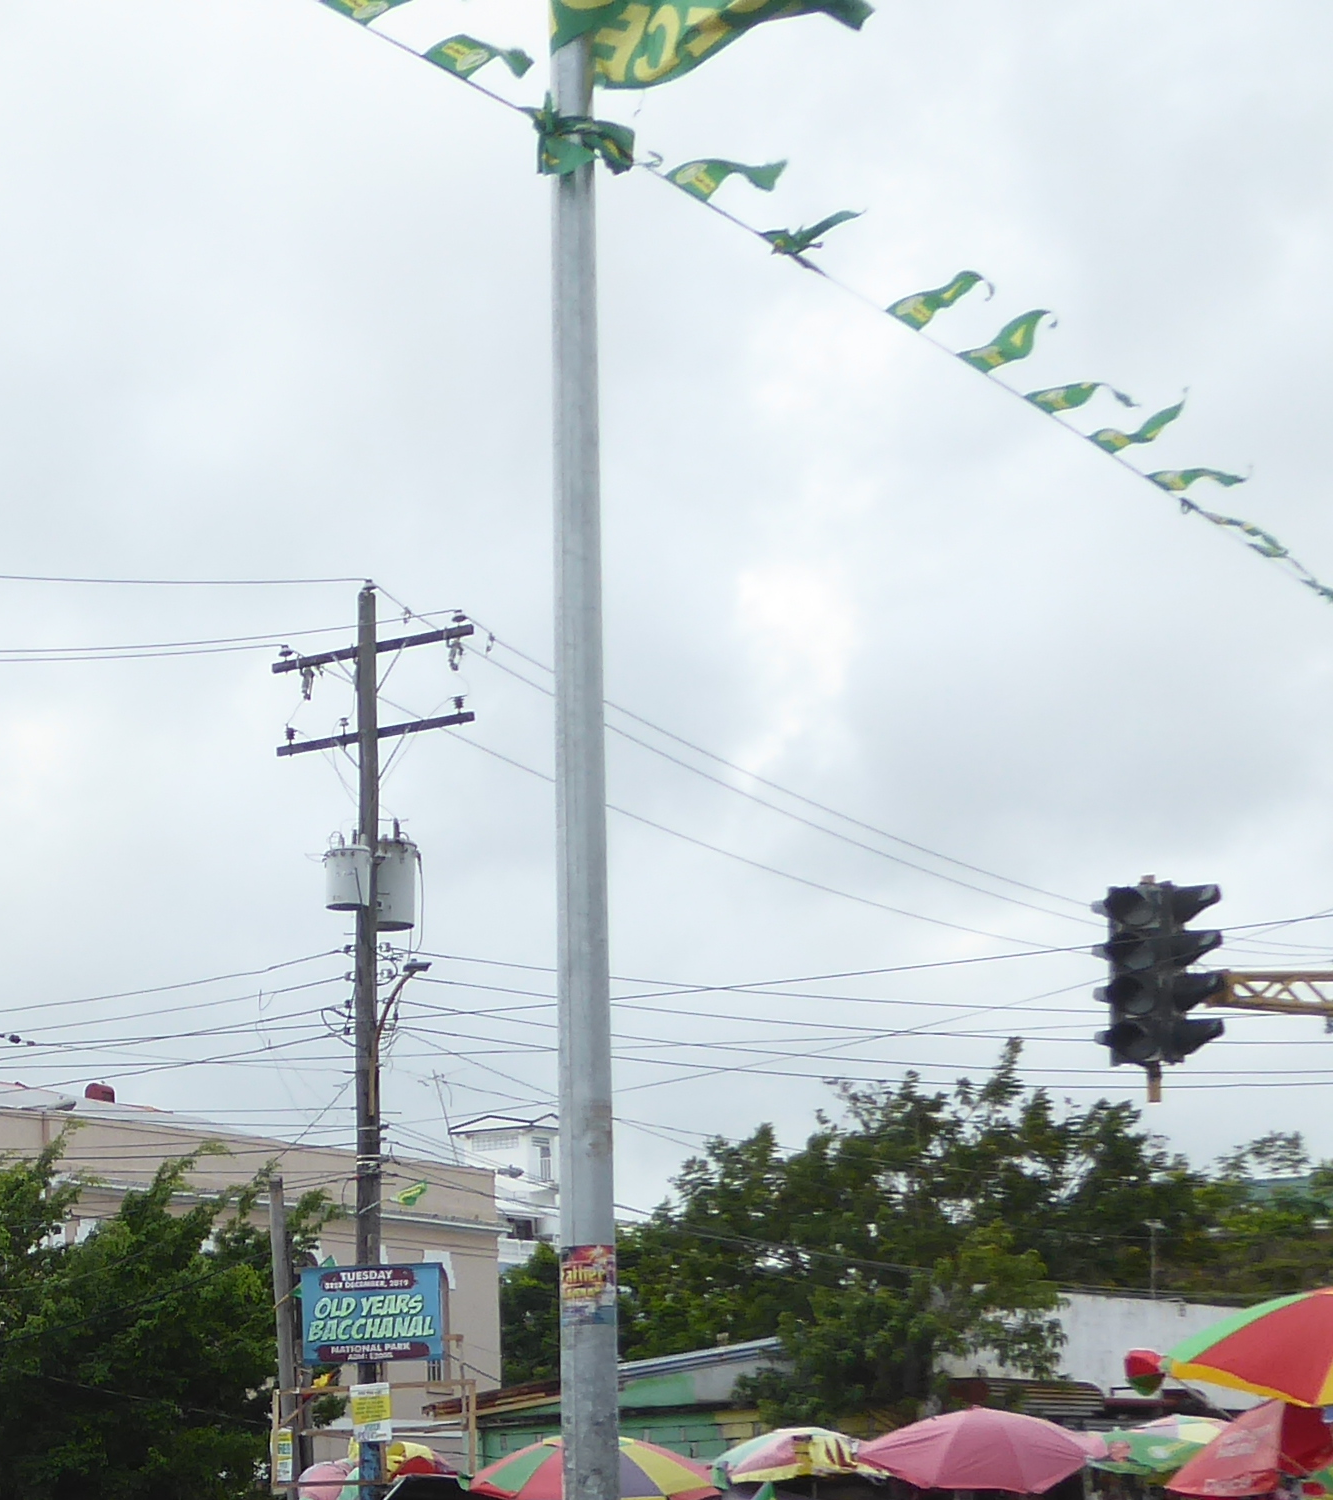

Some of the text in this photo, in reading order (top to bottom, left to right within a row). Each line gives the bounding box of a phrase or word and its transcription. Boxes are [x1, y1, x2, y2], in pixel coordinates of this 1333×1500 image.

[339, 1270, 393, 1281] TUESDAY
[313, 1294, 424, 1319] OLD YEARS
[307, 1316, 436, 1342] BACCHANAL
[331, 1342, 411, 1354] NATIONAL PARK
